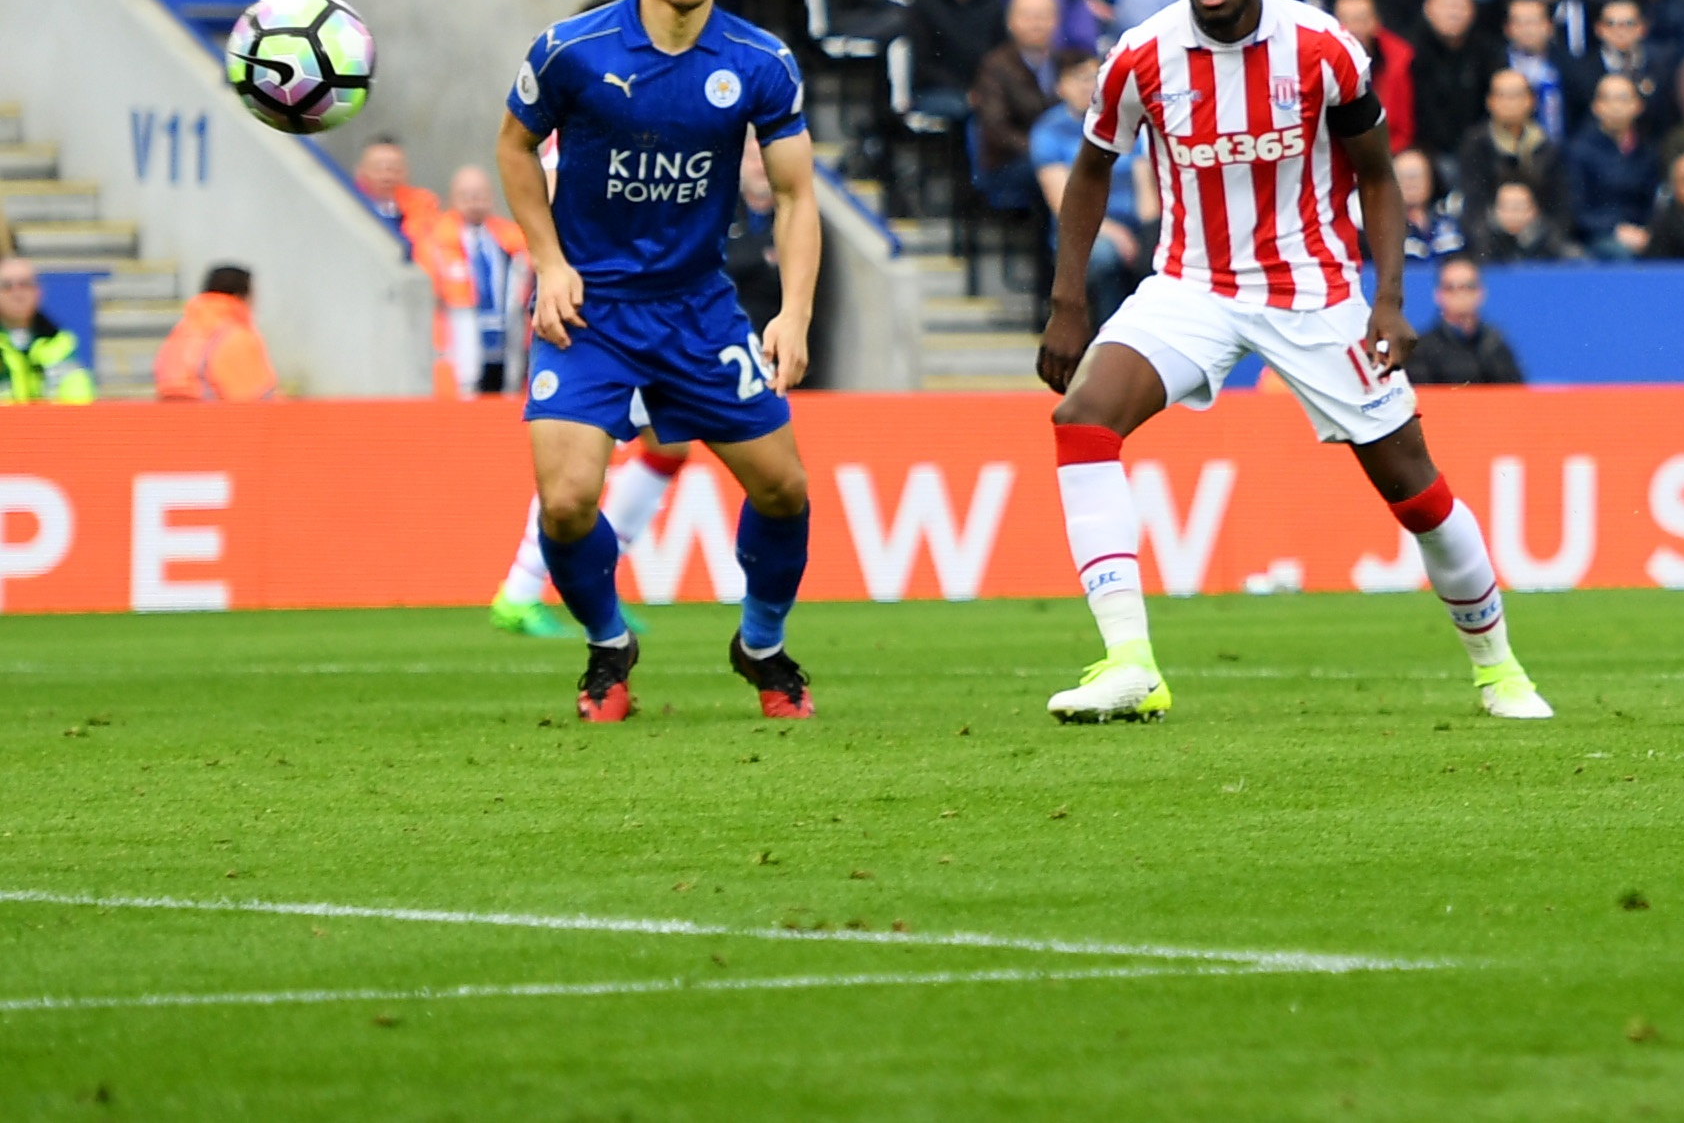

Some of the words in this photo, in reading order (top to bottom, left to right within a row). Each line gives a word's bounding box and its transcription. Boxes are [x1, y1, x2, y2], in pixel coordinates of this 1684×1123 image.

[130, 108, 209, 184] V11
[608, 148, 713, 180] KING
[1167, 127, 1306, 168] bet365
[606, 178, 708, 204] POWER
